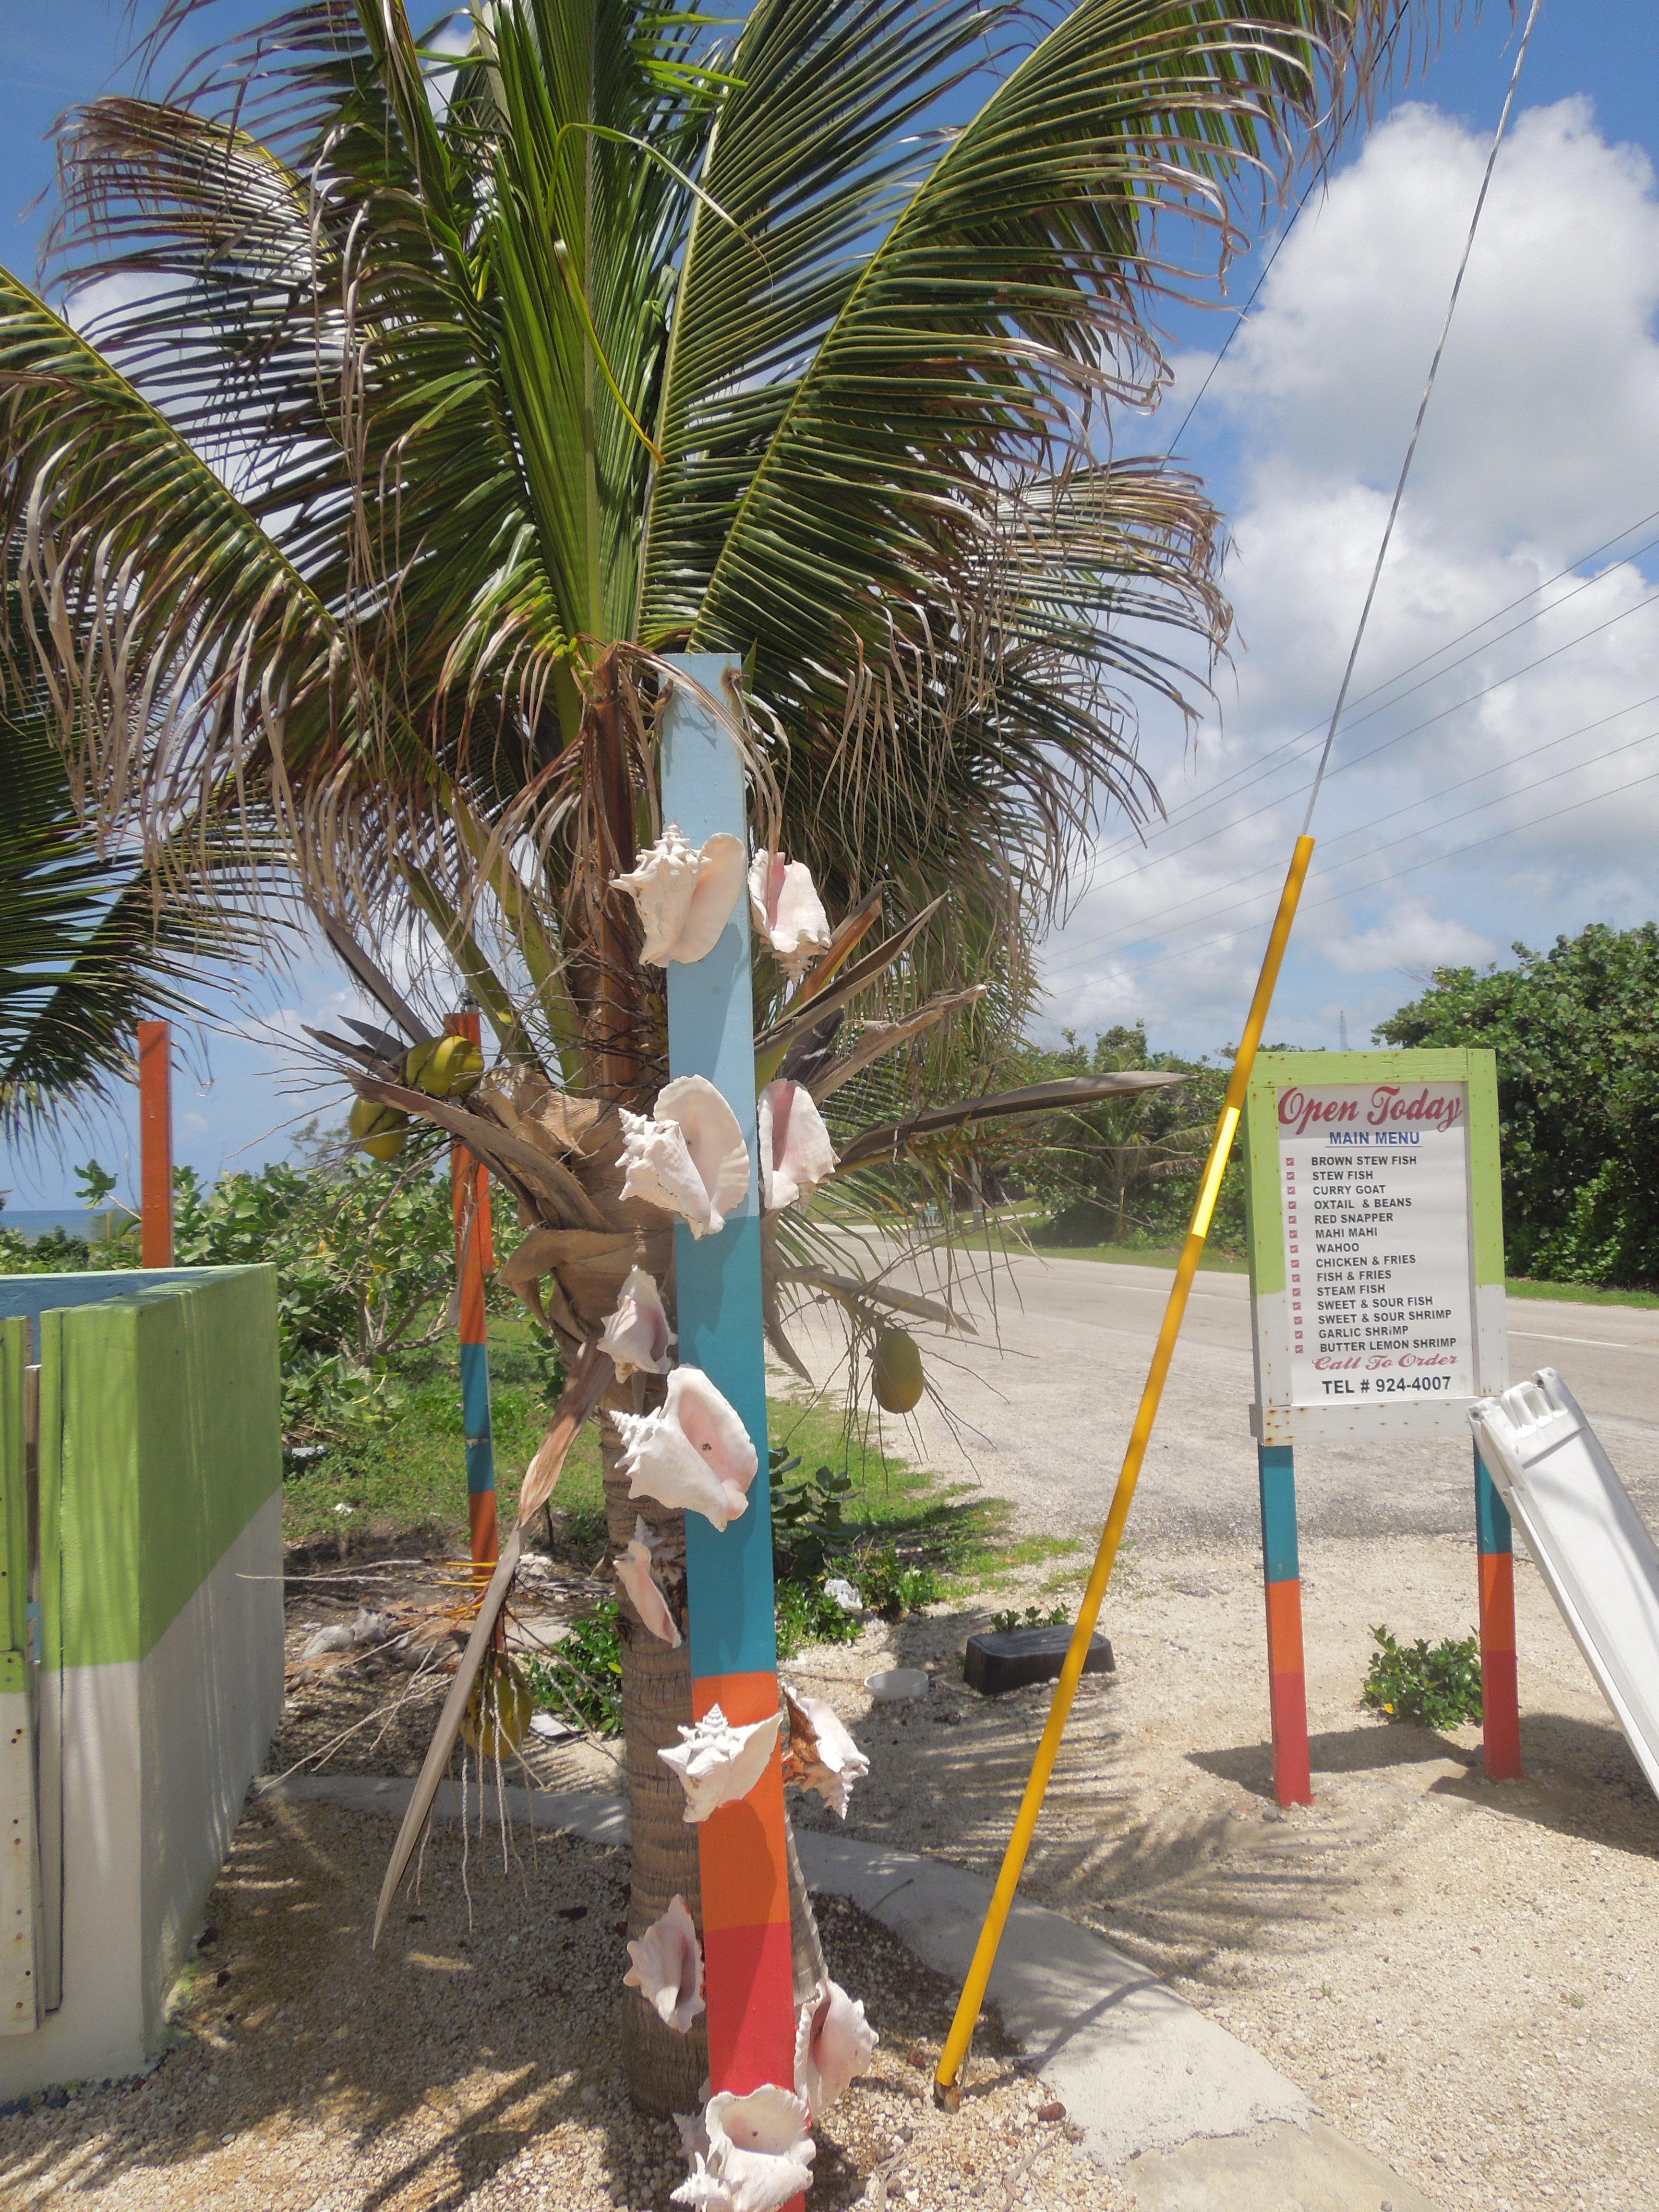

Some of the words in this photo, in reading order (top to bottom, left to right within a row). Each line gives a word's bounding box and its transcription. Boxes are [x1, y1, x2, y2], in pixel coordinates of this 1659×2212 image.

[1278, 1087, 1359, 1135] Open
[1367, 1086, 1463, 1132] Today
[1329, 1132, 1370, 1144] MAIN
[1375, 1131, 1419, 1144] MENU
[1311, 1156, 1353, 1166] BROWN
[1357, 1156, 1388, 1166] STEW
[1392, 1155, 1417, 1165] FISH
[1312, 1171, 1344, 1181] STEW
[1347, 1170, 1373, 1180] FISH
[1313, 1185, 1352, 1195] CURRY
[1355, 1184, 1386, 1195] GOAT
[1314, 1199, 1355, 1210] OXTAIL
[1362, 1199, 1370, 1208] &
[1374, 1197, 1412, 1208] BEANS
[1315, 1214, 1337, 1224] RED
[1341, 1212, 1394, 1224] SNAPPER
[1315, 1228, 1345, 1238] MAHI
[1348, 1227, 1377, 1238] MAHI
[1316, 1242, 1359, 1253] WAHOO
[1316, 1257, 1368, 1268] CHICKEN
[1372, 1256, 1380, 1265] &
[1384, 1254, 1416, 1265] FRIES
[1317, 1272, 1343, 1282] FISH
[1347, 1271, 1355, 1281] &
[1359, 1270, 1392, 1280] FRIES
[1317, 1286, 1356, 1297] STEAM
[1359, 1284, 1385, 1294] FISH
[1317, 1299, 1356, 1310] SWEET
[1360, 1299, 1369, 1309] &
[1372, 1298, 1404, 1308] SOUR
[1407, 1296, 1433, 1306] FISH
[1318, 1314, 1358, 1324] SWEET
[1361, 1313, 1370, 1323] &
[1373, 1311, 1405, 1322] SOUR
[1408, 1309, 1452, 1321] SHRIMP
[1319, 1327, 1361, 1339] GARLIC
[1320, 1342, 1366, 1353] BUTTER
[1370, 1340, 1409, 1350] LEMON
[1413, 1337, 1456, 1349] SHRIMP
[1311, 1356, 1361, 1370] Call
[1365, 1355, 1393, 1370] To
[1398, 1353, 1458, 1368] Order
[1322, 1380, 1355, 1395] TEL
[1360, 1379, 1370, 1394] #
[1375, 1376, 1451, 1393] 924-4007
